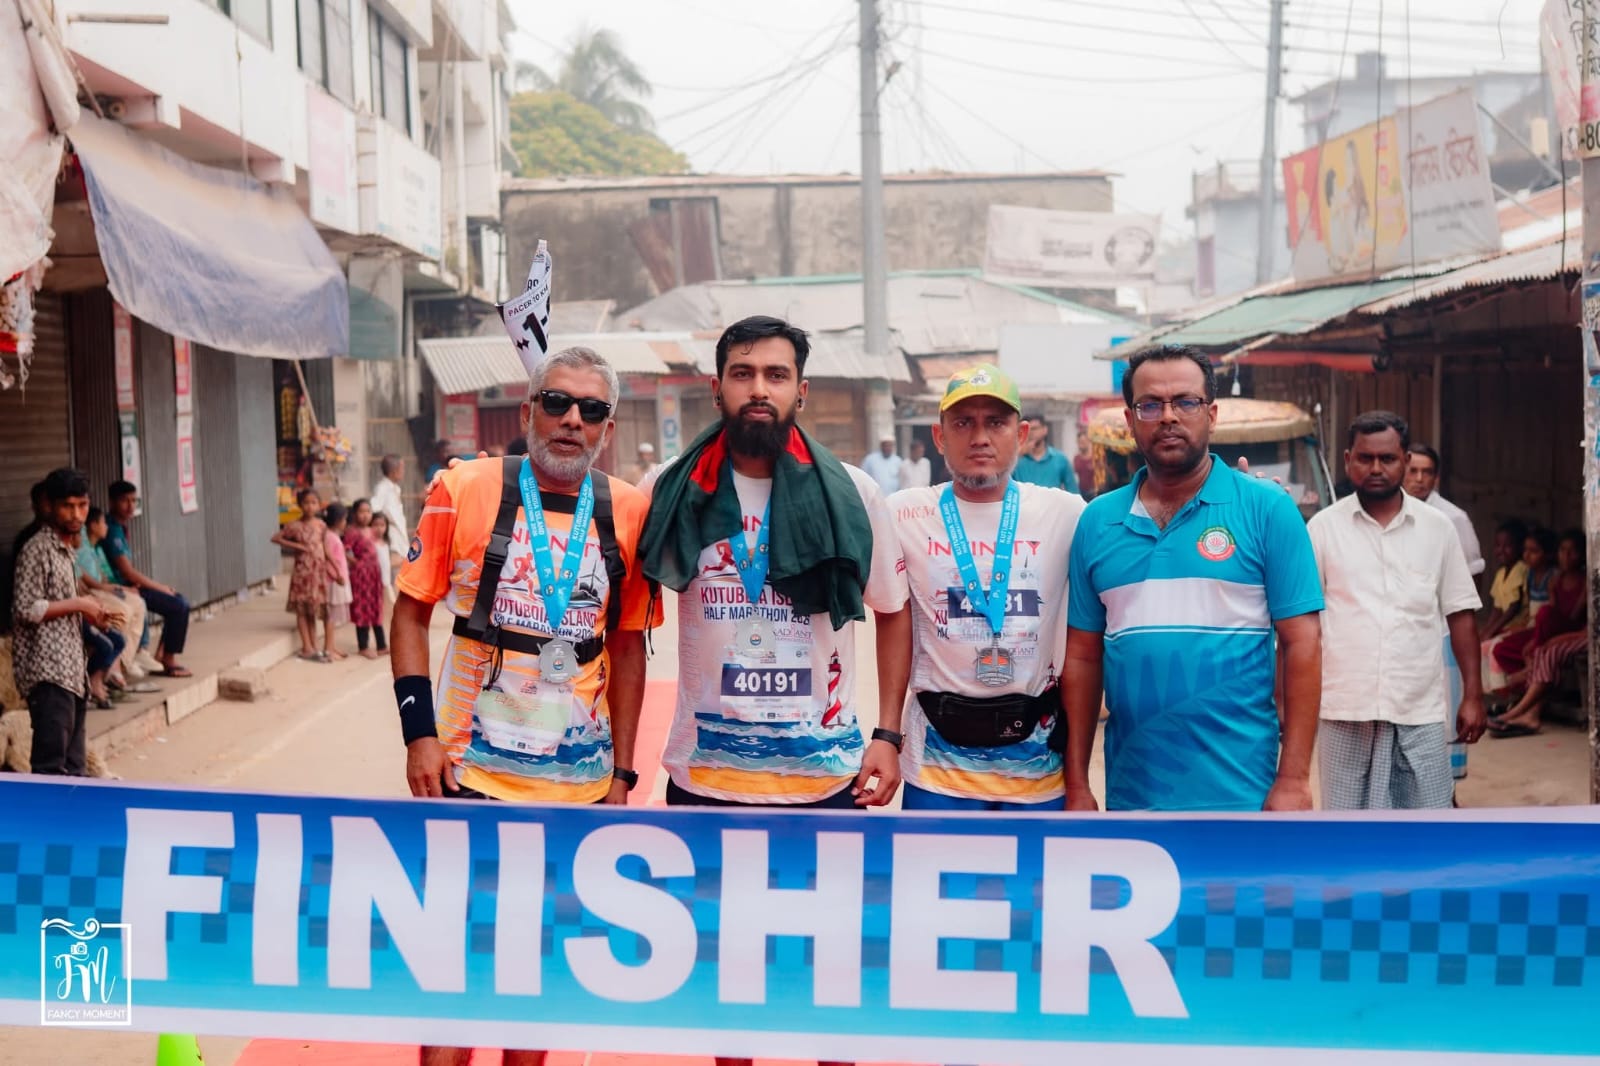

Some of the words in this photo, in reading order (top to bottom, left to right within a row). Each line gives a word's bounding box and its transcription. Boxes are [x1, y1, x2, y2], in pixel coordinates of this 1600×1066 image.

[508, 299, 532, 316] PACER
[532, 294, 540, 304] 10
[535, 511, 545, 535] ISLAND
[701, 587, 768, 605] KUTUBA
[561, 609, 597, 628] SLAND
[704, 606, 727, 620] HALF
[729, 607, 788, 623] MARTHON
[734, 672, 797, 692] 40191
[121, 807, 1190, 1018] FINISHER
